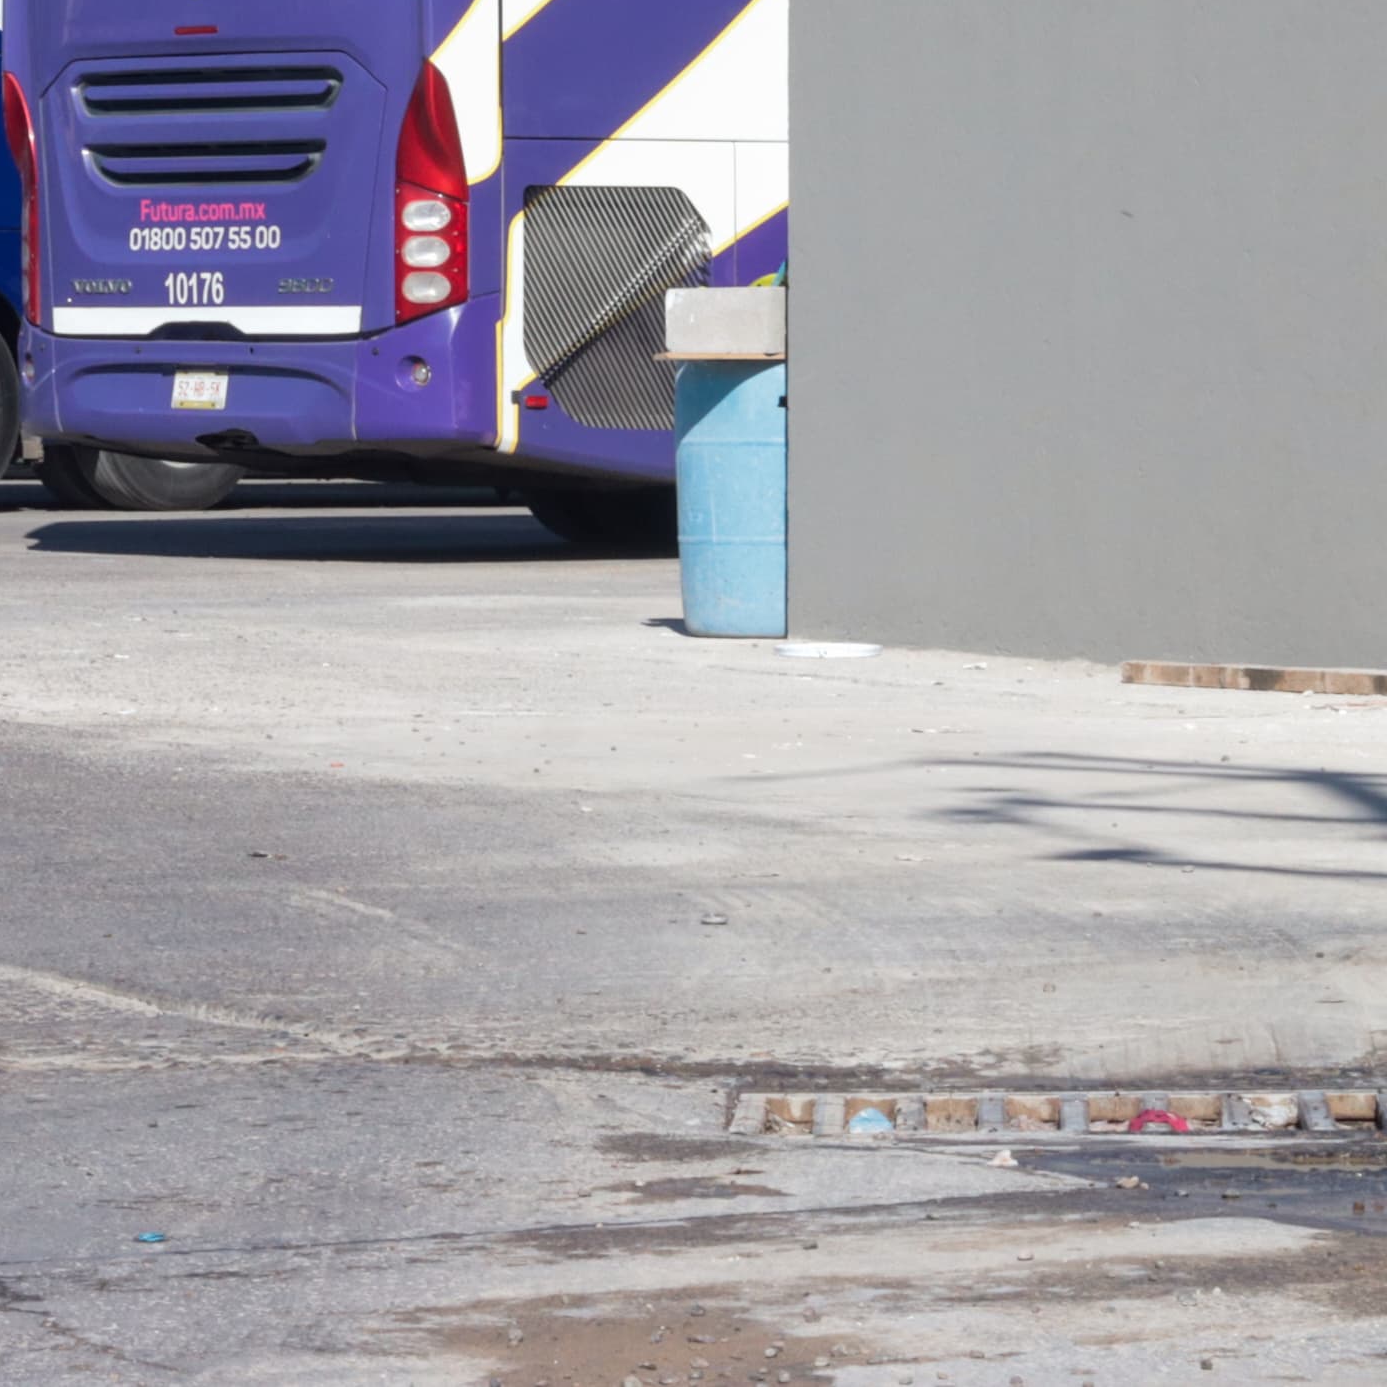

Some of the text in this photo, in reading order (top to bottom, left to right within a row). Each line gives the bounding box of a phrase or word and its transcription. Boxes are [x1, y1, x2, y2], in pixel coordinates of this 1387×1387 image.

[140, 199, 266, 222] Futura.com.mx
[129, 225, 281, 251] 01800 507 55 00
[71, 278, 133, 294] VOLVO
[164, 271, 225, 305] 10176
